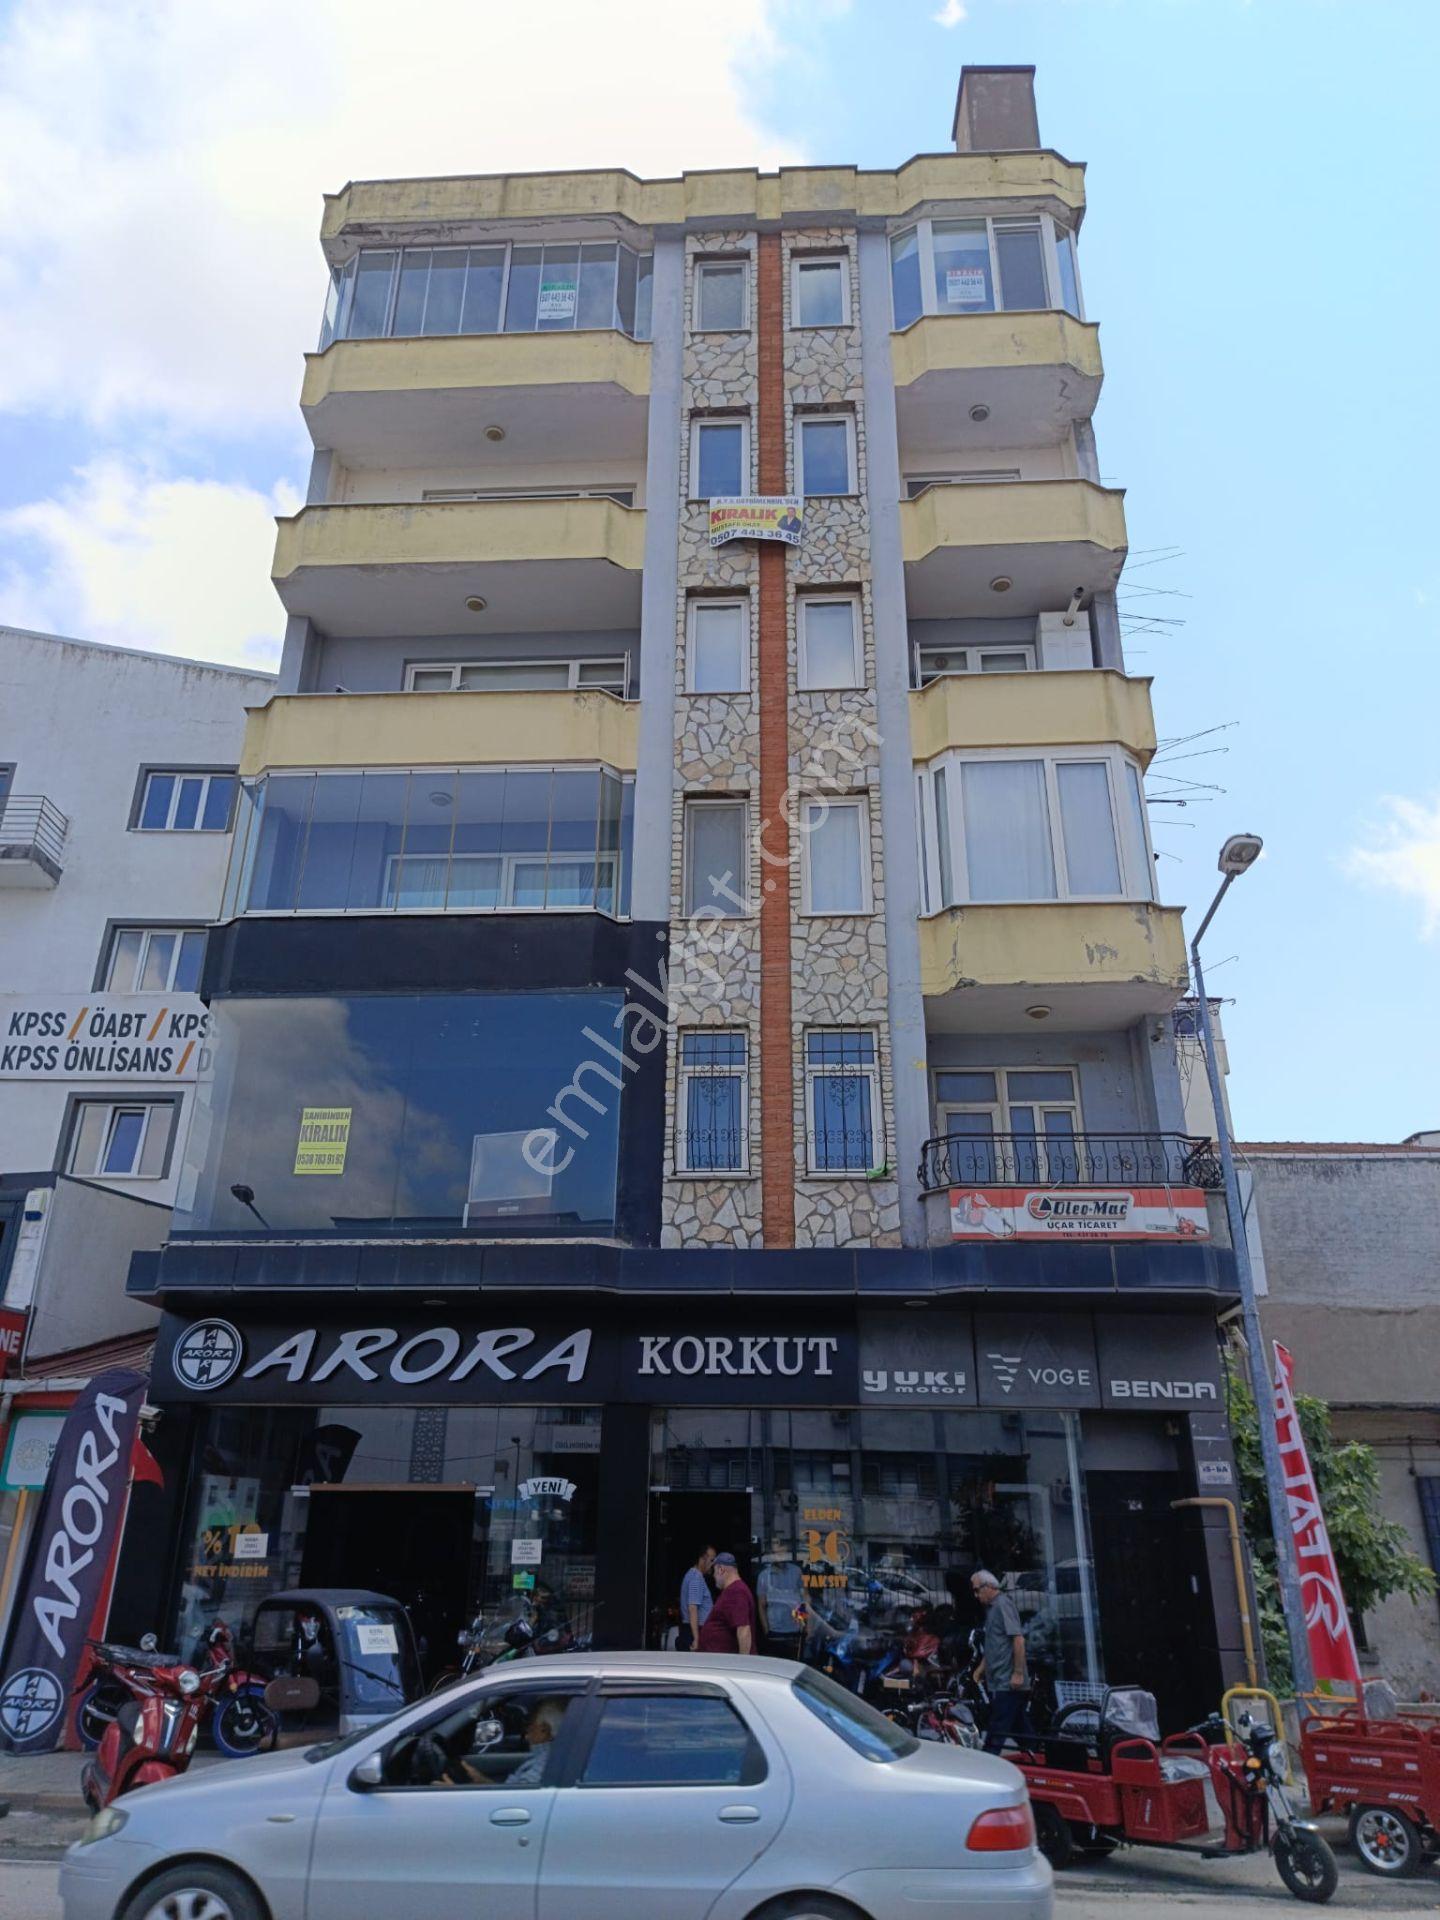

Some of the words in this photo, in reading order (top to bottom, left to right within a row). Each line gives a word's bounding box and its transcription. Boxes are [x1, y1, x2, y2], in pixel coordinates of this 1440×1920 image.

[711, 529, 738, 546] 0507
[741, 529, 763, 537] 443
[767, 530, 782, 539] 36
[785, 532, 800, 544] 45
[8, 1012, 67, 1037] KPSS
[89, 1007, 147, 1038] ÖABT
[0, 1045, 60, 1071] KPSS
[64, 1040, 174, 1073] ÖNLİSANS
[1053, 1201, 1128, 1216] Oleo-Mac
[1047, 1221, 1075, 1231] UÇAR
[1079, 1218, 1118, 1229] TİCARET
[182, 1349, 233, 1358] ARORA
[243, 1327, 593, 1384] ARORA
[638, 1336, 838, 1376] KORKUT
[1027, 1368, 1091, 1386] VOGE
[895, 1385, 967, 1394] motor
[1110, 1380, 1217, 1400] BENDA
[532, 1479, 562, 1494] YENİ
[33, 1391, 128, 1658] ARORA
[800, 1529, 851, 1564] 36
